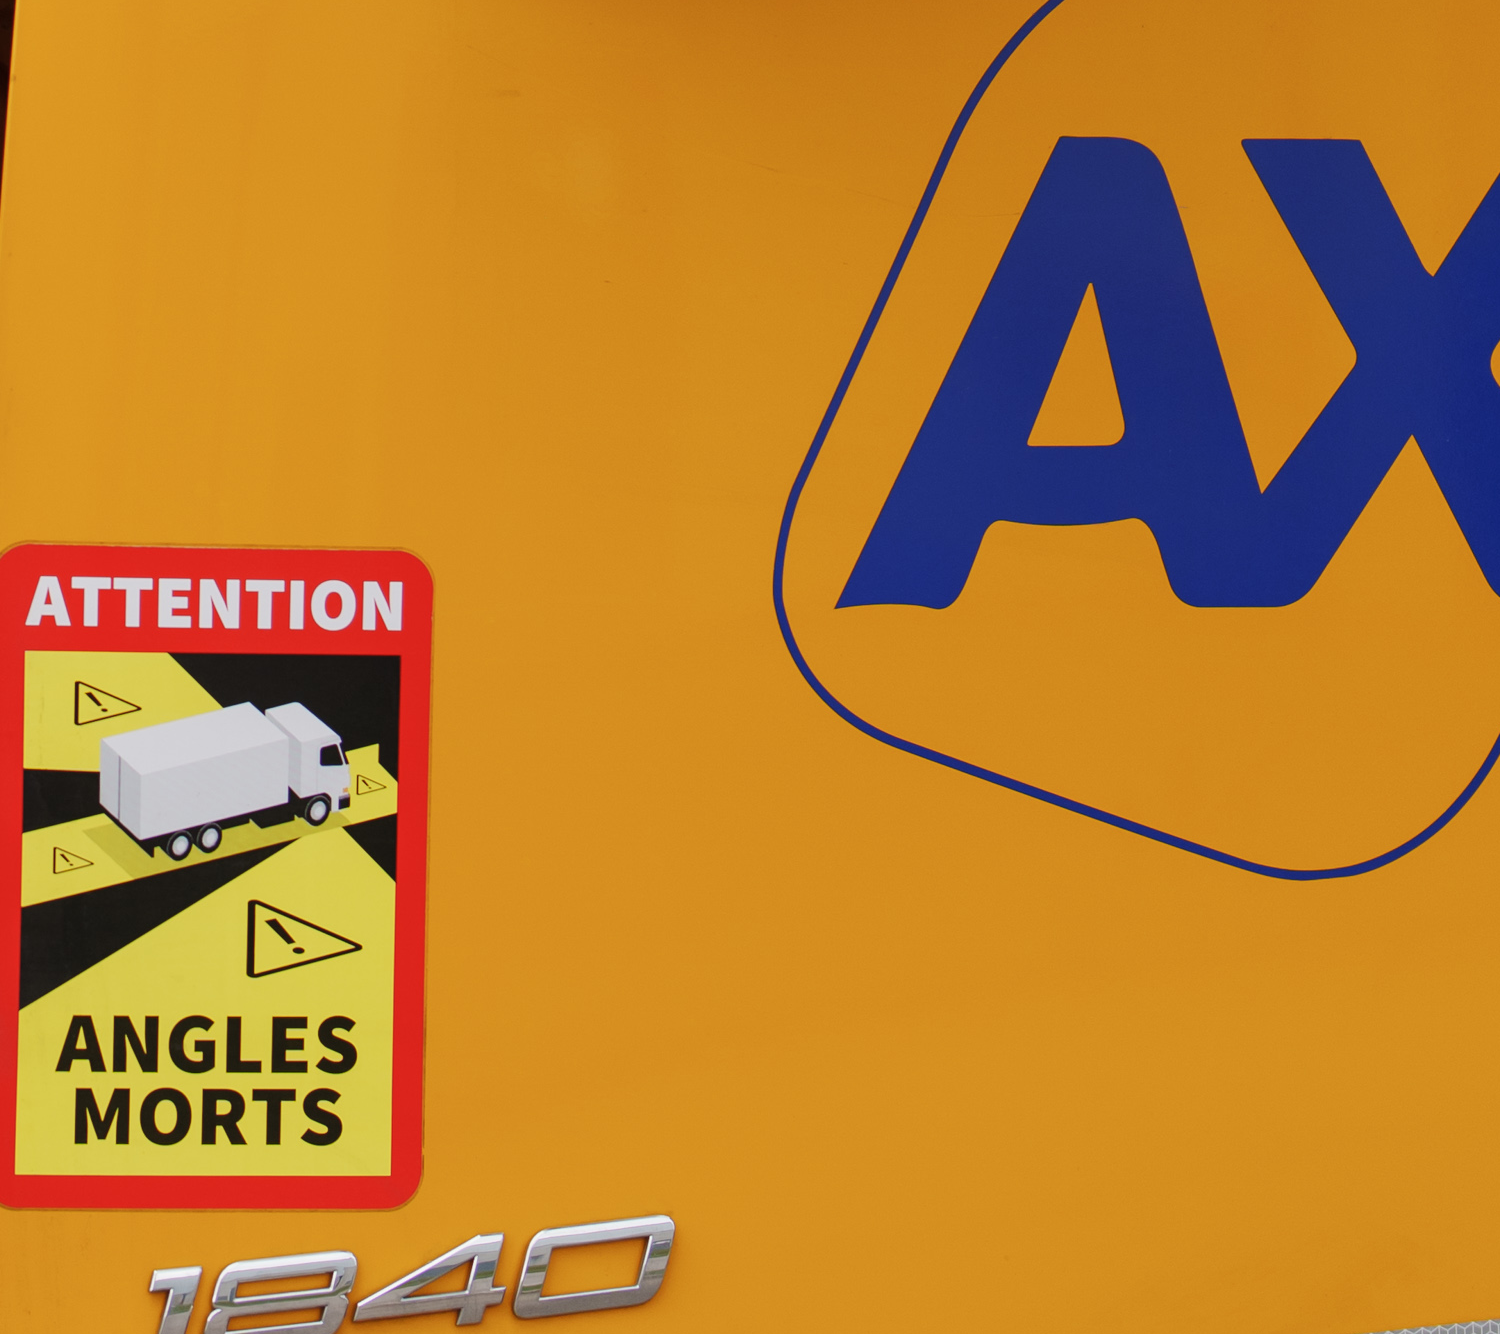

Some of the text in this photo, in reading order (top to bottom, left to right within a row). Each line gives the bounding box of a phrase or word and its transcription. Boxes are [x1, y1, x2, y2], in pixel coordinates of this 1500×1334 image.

[25, 576, 403, 631] ATTENTION
[55, 1015, 358, 1074] ANGLES
[74, 1087, 343, 1146] MORTS
